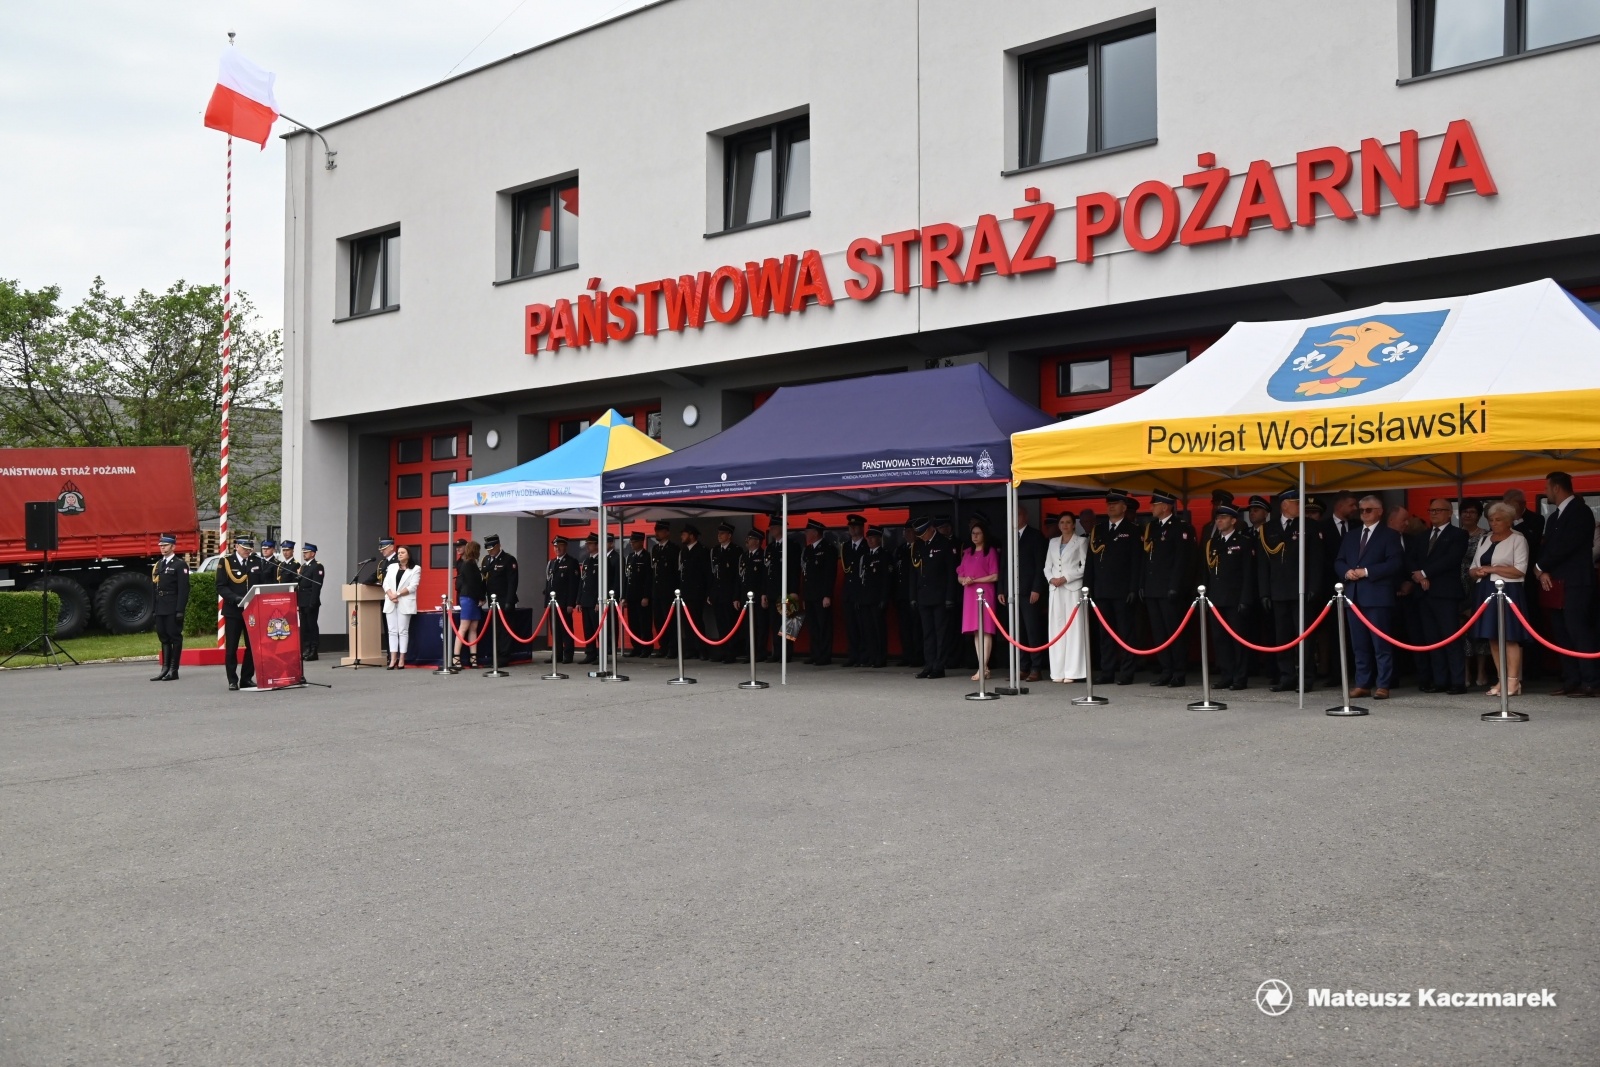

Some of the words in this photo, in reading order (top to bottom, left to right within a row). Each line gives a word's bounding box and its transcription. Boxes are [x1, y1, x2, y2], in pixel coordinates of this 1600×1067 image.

[525, 249, 834, 355] PAŃSTWOWA
[845, 187, 1056, 300] STRAŻ
[1076, 119, 1498, 264] POŻARNA
[1147, 423, 1247, 455] Powiat
[1257, 400, 1487, 451] Wodzisławski
[60, 466, 91, 476] STRAŻ
[93, 465, 136, 475] POŻARNA
[861, 459, 910, 470] PAŃSTWOWA
[911, 456, 935, 467] STRAŻ
[936, 455, 974, 465] POŻARNA
